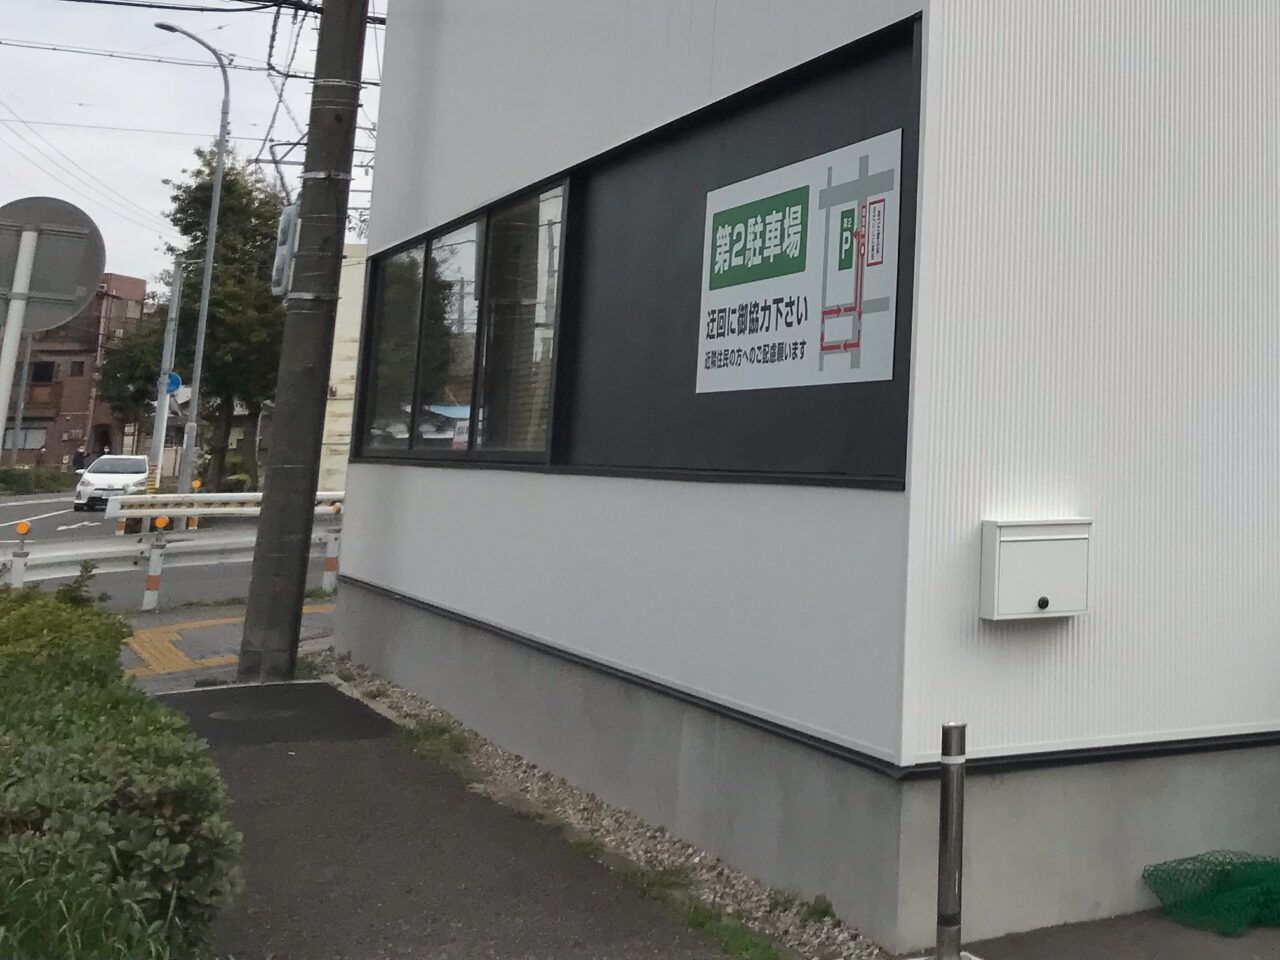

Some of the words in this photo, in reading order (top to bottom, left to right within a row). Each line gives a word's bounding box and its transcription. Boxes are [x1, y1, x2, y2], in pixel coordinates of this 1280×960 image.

[713, 203, 803, 275] 第2駐車場
[841, 230, 851, 260] P
[706, 295, 808, 340] 迂回に御協力下さい
